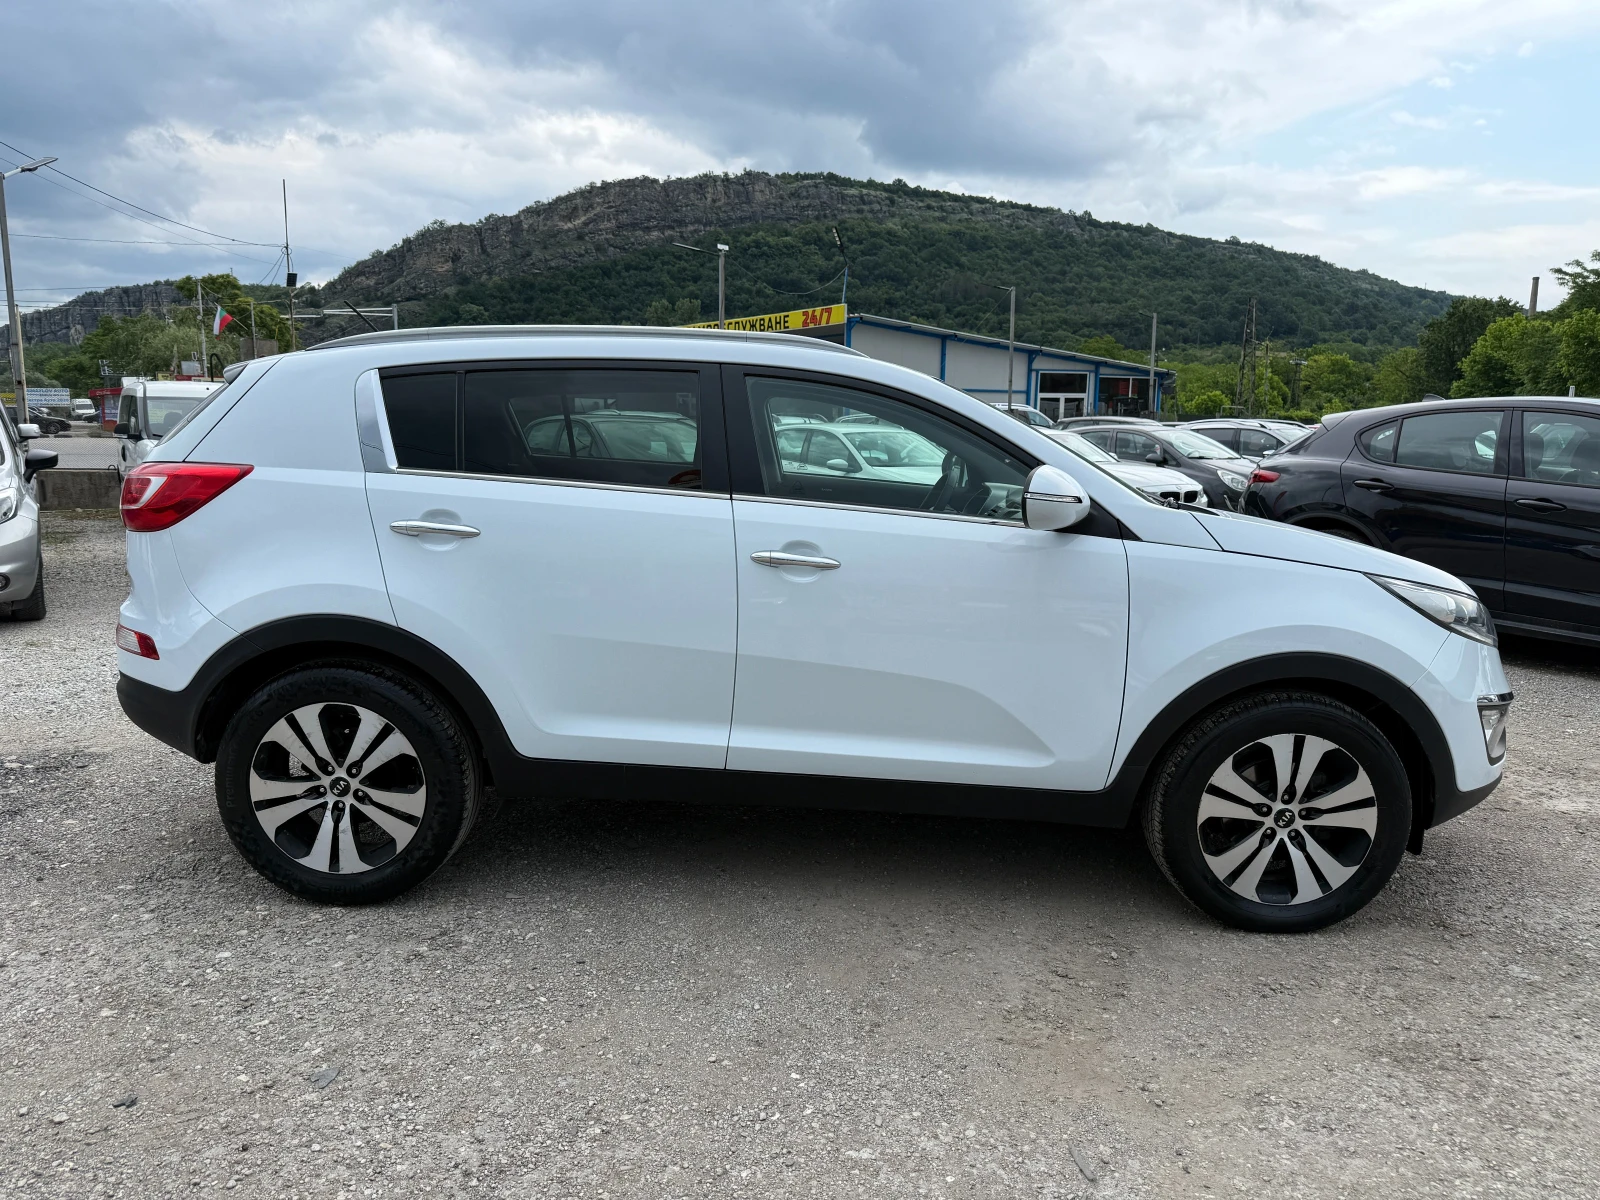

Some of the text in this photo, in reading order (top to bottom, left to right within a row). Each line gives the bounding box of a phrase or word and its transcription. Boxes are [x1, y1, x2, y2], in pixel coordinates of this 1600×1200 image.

[687, 307, 833, 332] СЛУЖВАНЕ 24/7
[332, 780, 348, 795] KIA
[1277, 812, 1293, 827] KIA
